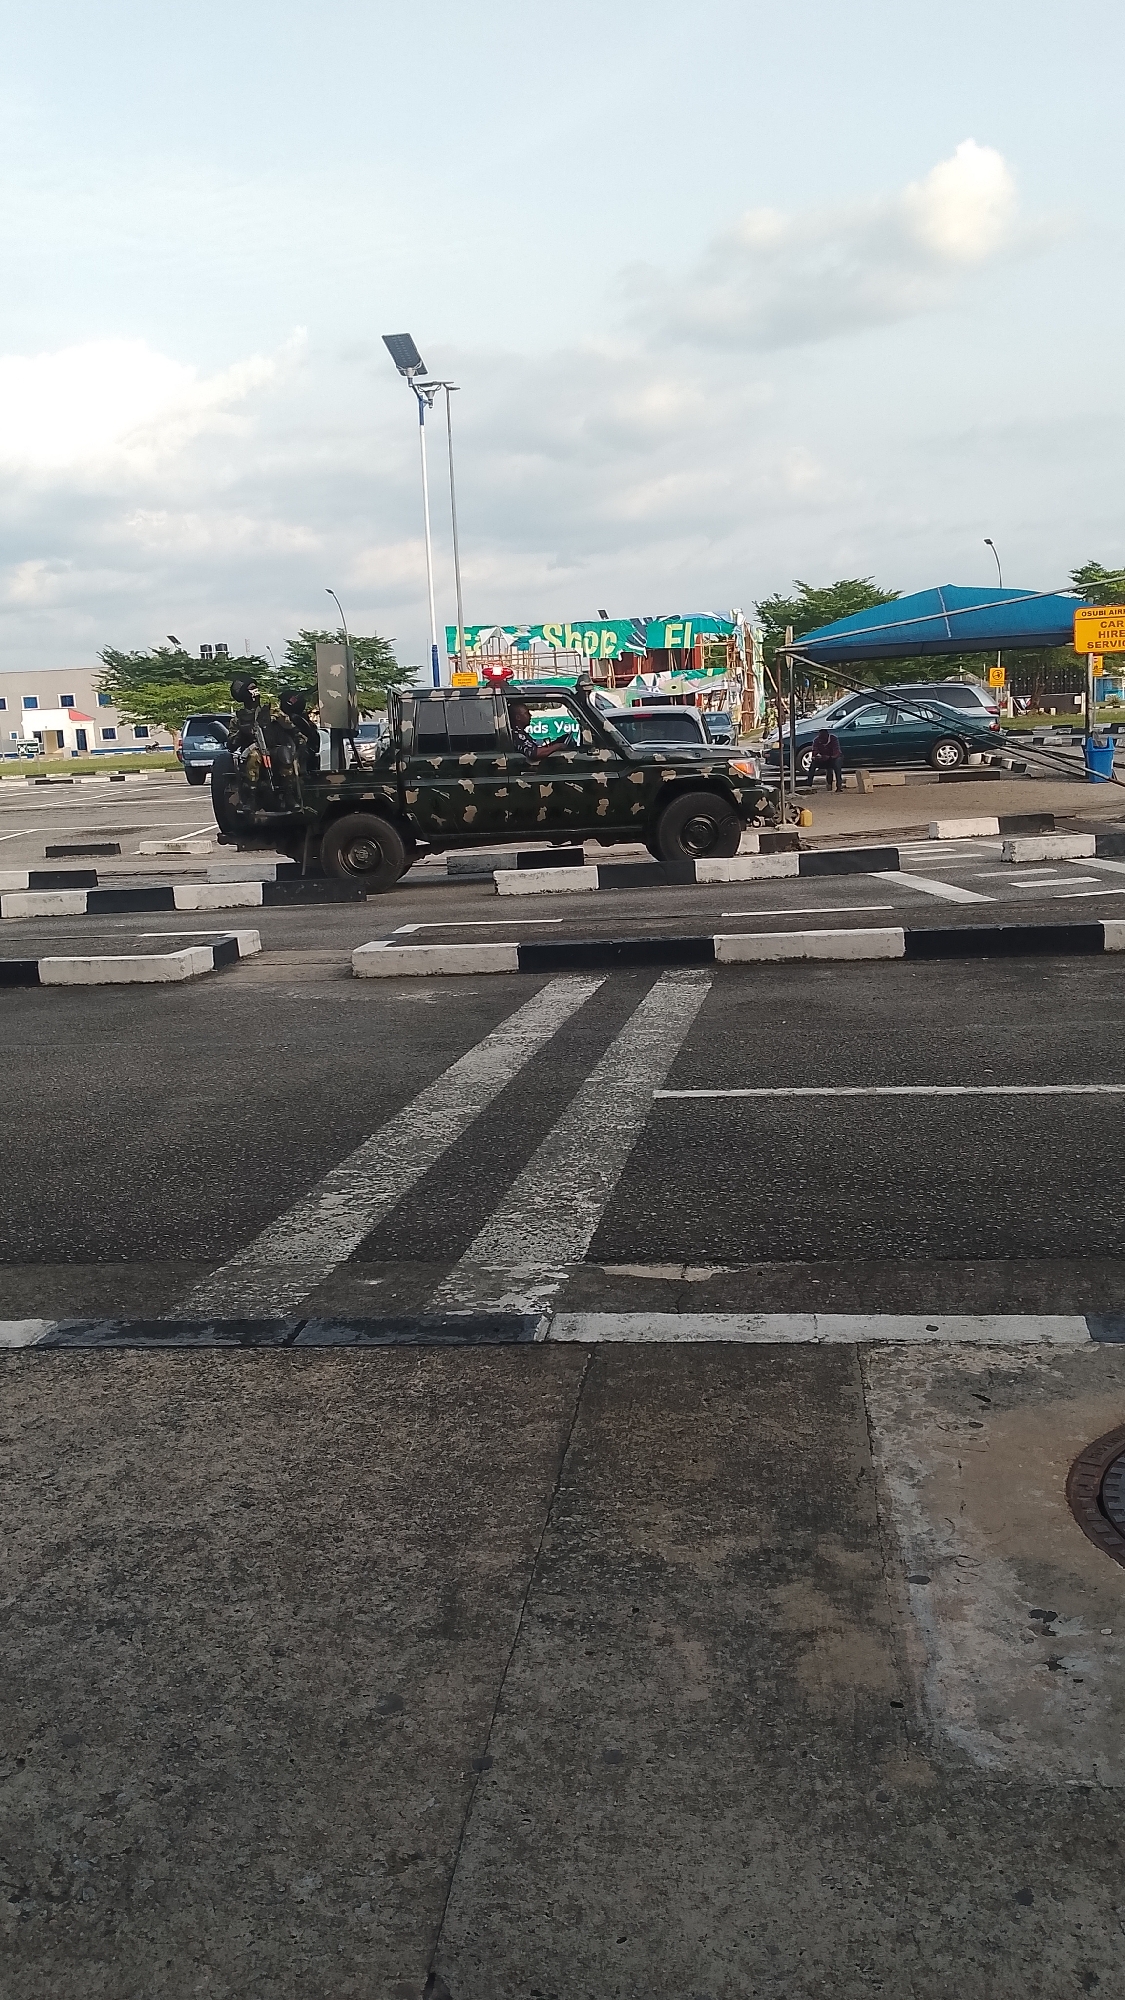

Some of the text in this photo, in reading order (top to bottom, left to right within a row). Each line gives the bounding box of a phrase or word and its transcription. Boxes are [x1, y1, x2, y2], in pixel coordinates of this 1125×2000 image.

[1100, 620, 1124, 628] CAR
[1098, 630, 1125, 639] HIRE
[543, 624, 618, 658] Shop
